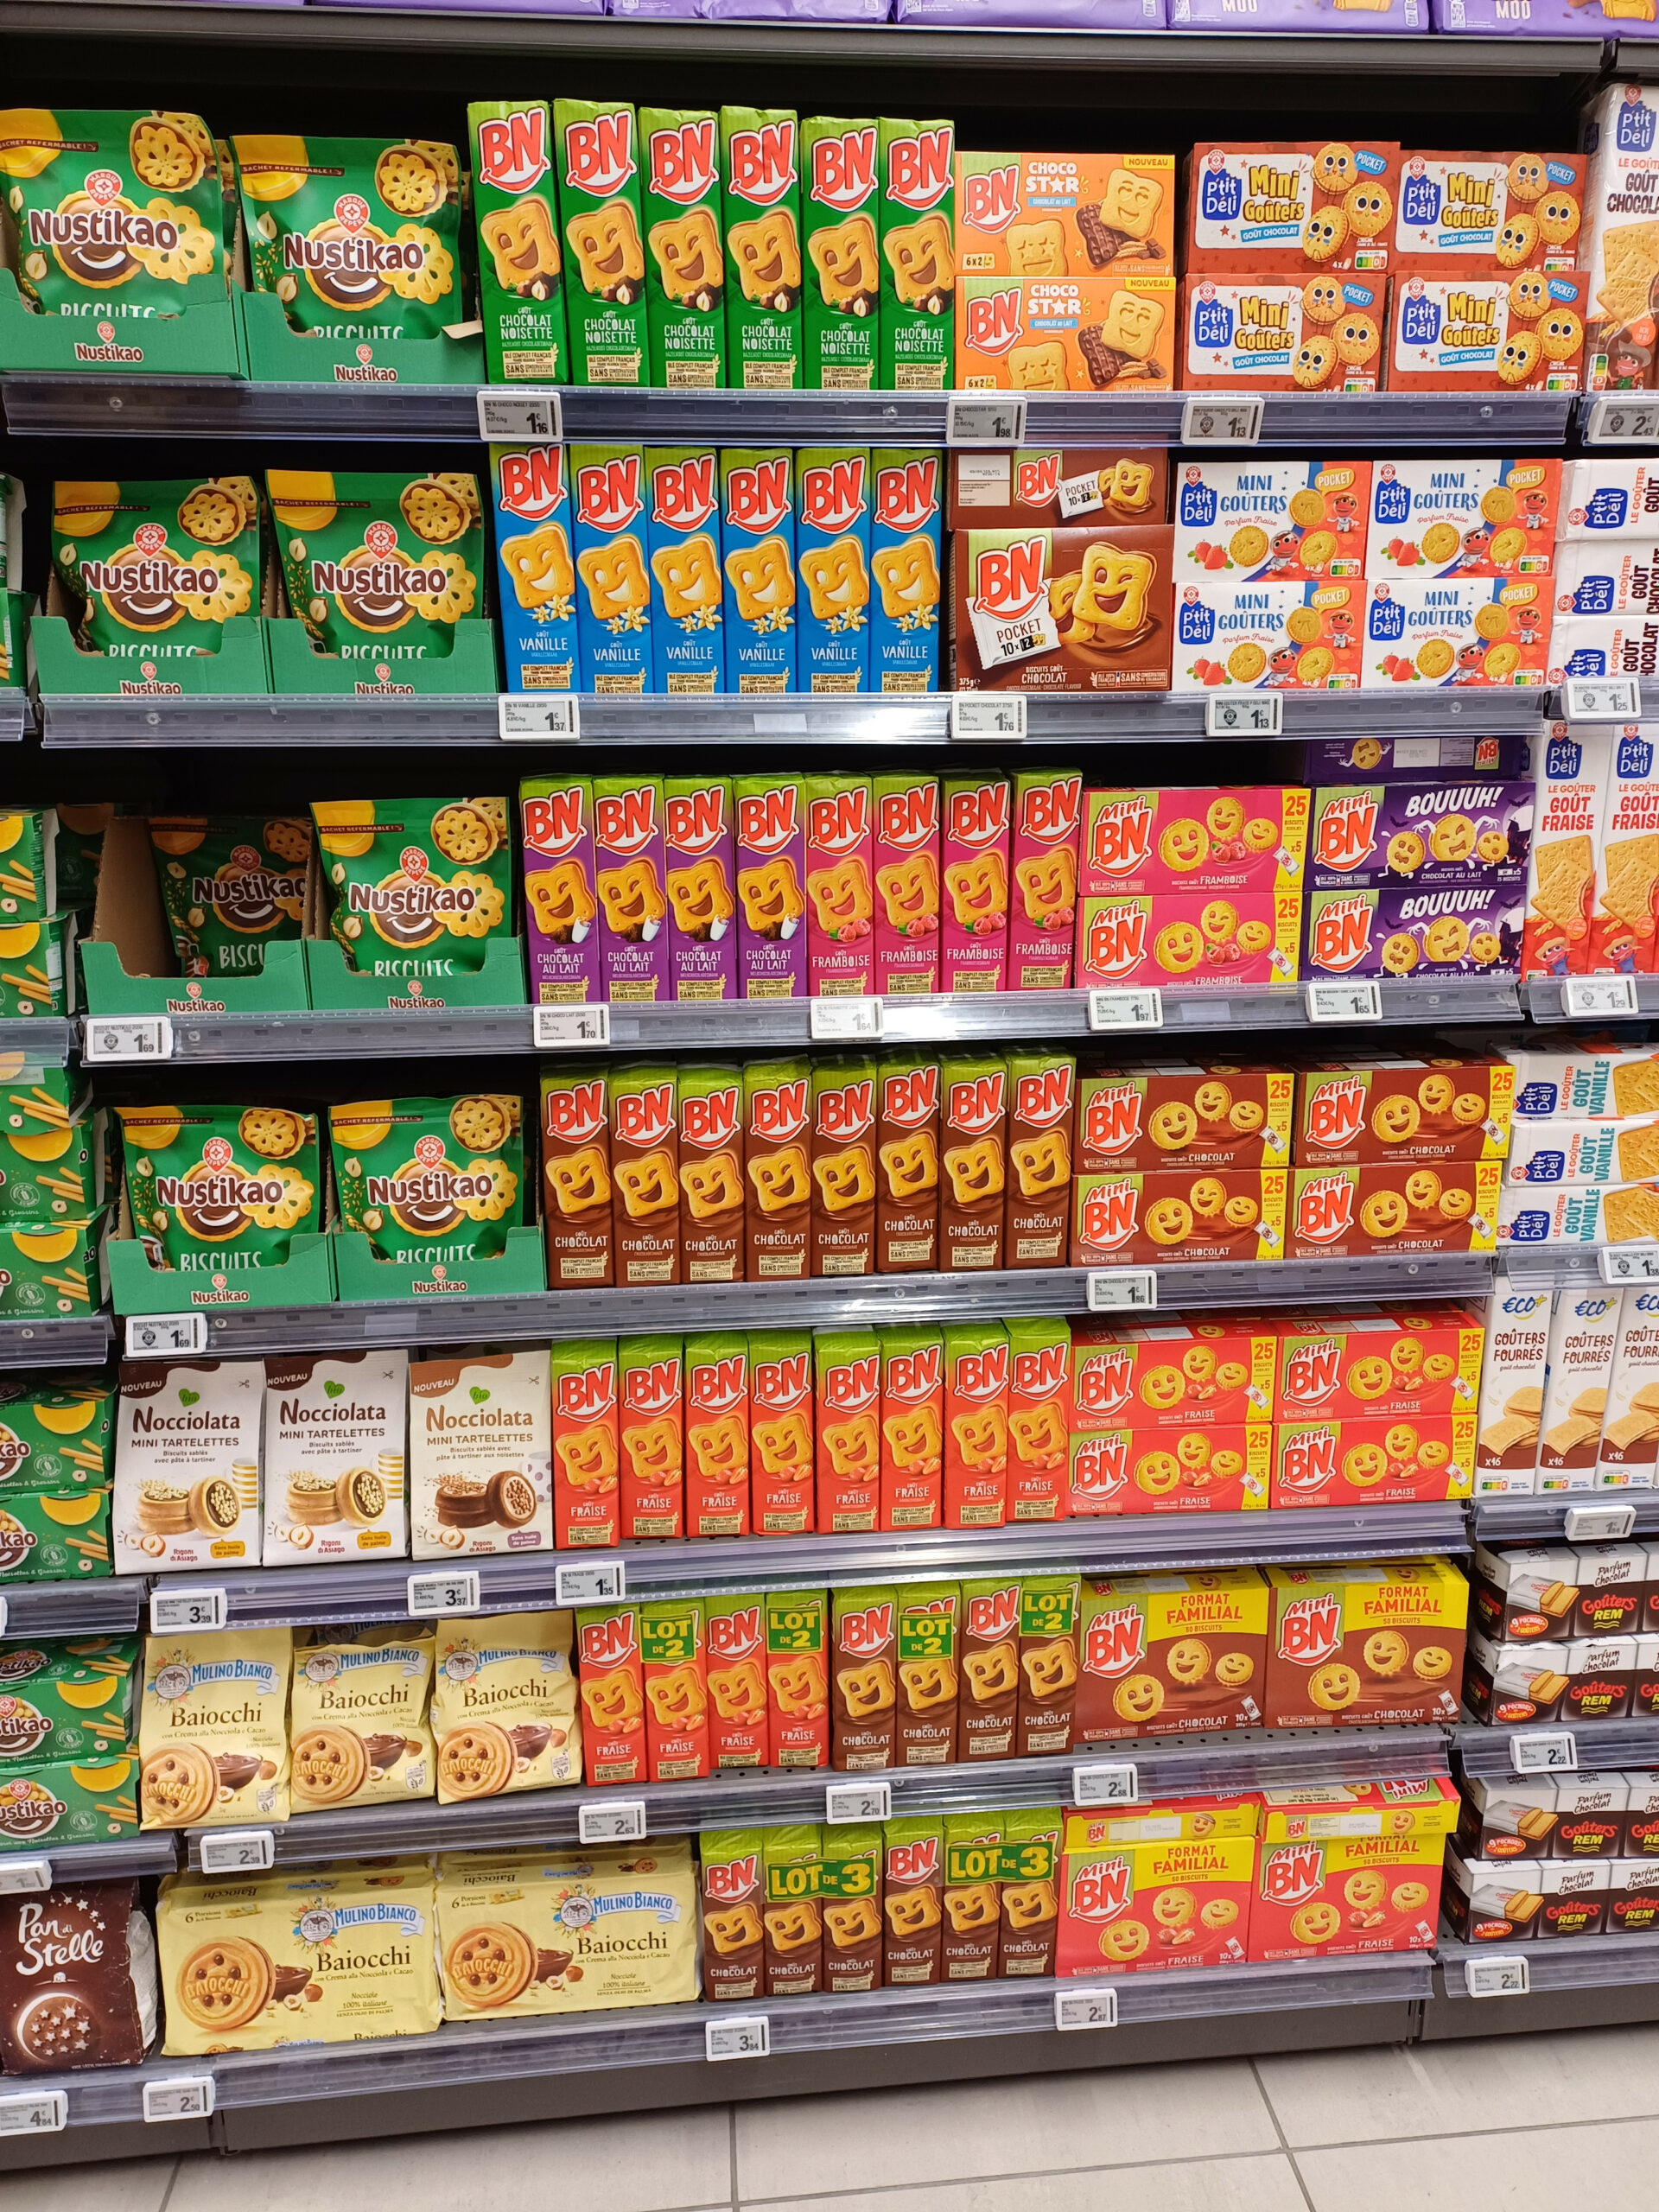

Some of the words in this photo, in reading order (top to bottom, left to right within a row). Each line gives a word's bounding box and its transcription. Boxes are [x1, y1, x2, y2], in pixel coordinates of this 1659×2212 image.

[480, 111, 543, 173] BN
[1028, 162, 1077, 175] CHOCO
[1357, 153, 1385, 171] POCKET
[1249, 166, 1300, 199] Mini
[1626, 172, 1659, 199] GOÛT
[1206, 195, 1237, 215] Déli
[1243, 200, 1304, 222] Goûters
[29, 211, 178, 250] Nustikao
[1243, 229, 1262, 239] GOÛT
[1264, 226, 1299, 238] CHOCOLAT
[283, 233, 423, 270] Nustikao
[1448, 291, 1497, 323] Mini
[499, 315, 551, 328] CHOCOLAT
[501, 327, 553, 340] NOISETTE
[1440, 325, 1500, 347] Goûters
[821, 343, 871, 355] NOISETTE
[500, 448, 560, 505] BN
[1237, 475, 1272, 491] MINI
[1510, 470, 1542, 484] POCKET
[1065, 480, 1096, 496] POCKET
[1221, 493, 1287, 513] GOÛTERS
[1379, 504, 1405, 518] Déli
[1224, 518, 1252, 527] Parfum
[1255, 516, 1277, 526] Fraise
[980, 542, 1043, 607] BN
[1618, 555, 1632, 597] GOÛTER
[1425, 591, 1459, 606] MINI
[1618, 600, 1627, 610] LE
[1408, 609, 1472, 626] GOÛTERS
[996, 619, 1042, 643] POCKET
[519, 638, 568, 652] VANILLE
[666, 646, 714, 659] VANILLE
[882, 645, 928, 658] VANILLE
[1022, 672, 1067, 683] CHOCOLAT
[1121, 673, 1141, 682] SANS
[1549, 760, 1577, 775] Déli
[1548, 785, 1559, 793] LE
[1560, 782, 1596, 793] GOÛTER
[1286, 796, 1306, 817] 25
[1405, 787, 1504, 817] BOUUUH!
[1549, 795, 1591, 812] GOÛT
[1541, 814, 1594, 831] FRAISE
[1291, 841, 1302, 853] x5
[1200, 875, 1248, 885] FRAMBOISE
[1400, 889, 1495, 919] BOUUUH!
[537, 952, 585, 963] CHOCOLAT
[812, 954, 870, 967] FRAMBOISE
[946, 948, 1004, 960] FRAMBOISE
[542, 963, 557, 974] AU
[559, 962, 580, 974] LAIT
[1493, 1072, 1513, 1091] 25
[1091, 1082, 1135, 1105] Mini
[1497, 1113, 1509, 1124] x5
[1568, 1134, 1581, 1166] GOÛTER
[1594, 1127, 1615, 1182] VANILLE
[1567, 1167, 1575, 1178] LE
[157, 1176, 285, 1206] Nustikao
[366, 1173, 493, 1205] Nustikao
[1184, 1247, 1230, 1257] CHOCOLAT
[190, 1290, 251, 1304] Nustikao
[1495, 1329, 1546, 1345] GOÛTERS
[1255, 1343, 1274, 1359] 25
[1295, 1338, 1335, 1362] Mini
[1493, 1344, 1543, 1362] FOURRÉS
[121, 1380, 162, 1394] NOUVEAU
[565, 1367, 613, 1408] BN
[133, 1408, 241, 1434] Nocciolata
[426, 1405, 533, 1432] Nocciolata
[131, 1438, 156, 1448] MINI
[159, 1436, 239, 1448] TARTELETTES
[427, 1435, 450, 1445] MINI
[454, 1432, 533, 1444] TARTELETTES
[895, 1486, 930, 1498] FRAISE
[1179, 1497, 1211, 1506] FRAISE
[1598, 1560, 1630, 1575] Parfum
[1594, 1570, 1630, 1586] Chocolat
[1181, 1594, 1230, 1606] FORMAT
[1287, 1595, 1334, 1618] Mini
[1581, 1594, 1637, 1614] Goûters
[1166, 1605, 1243, 1624] FAMILIAL
[1593, 1609, 1624, 1620] REM
[643, 1619, 690, 1642] LOT
[653, 1646, 664, 1655] DE
[665, 1638, 685, 1659] 2
[191, 1663, 232, 1684] MULINO
[233, 1661, 272, 1681] BIANCO
[170, 1703, 262, 1728] Baiocchi
[175, 1730, 198, 1739] Crema
[211, 1727, 242, 1737] Nocciola
[596, 1745, 632, 1757] FRAISE
[1560, 1821, 1618, 1839] Goûters
[1573, 1834, 1604, 1845] REM
[892, 1841, 936, 1872] BN
[1167, 1846, 1216, 1858] FORMAT
[1153, 1857, 1230, 1875] FAMILIAL
[771, 1866, 823, 1895] LOT
[823, 1875, 838, 1885] DE
[841, 1861, 871, 1895] 3
[1076, 1866, 1128, 1914] BN
[17, 1903, 59, 1941] Pan
[62, 1925, 73, 1935] di
[335, 1907, 377, 1928] MULINO
[378, 1905, 417, 1922] BIANCO
[1357, 1939, 1394, 1948] FRAISE
[16, 1936, 105, 1974] Stelle
[316, 1946, 412, 1971] Baiocchi
[602, 1980, 620, 1990] 100%
